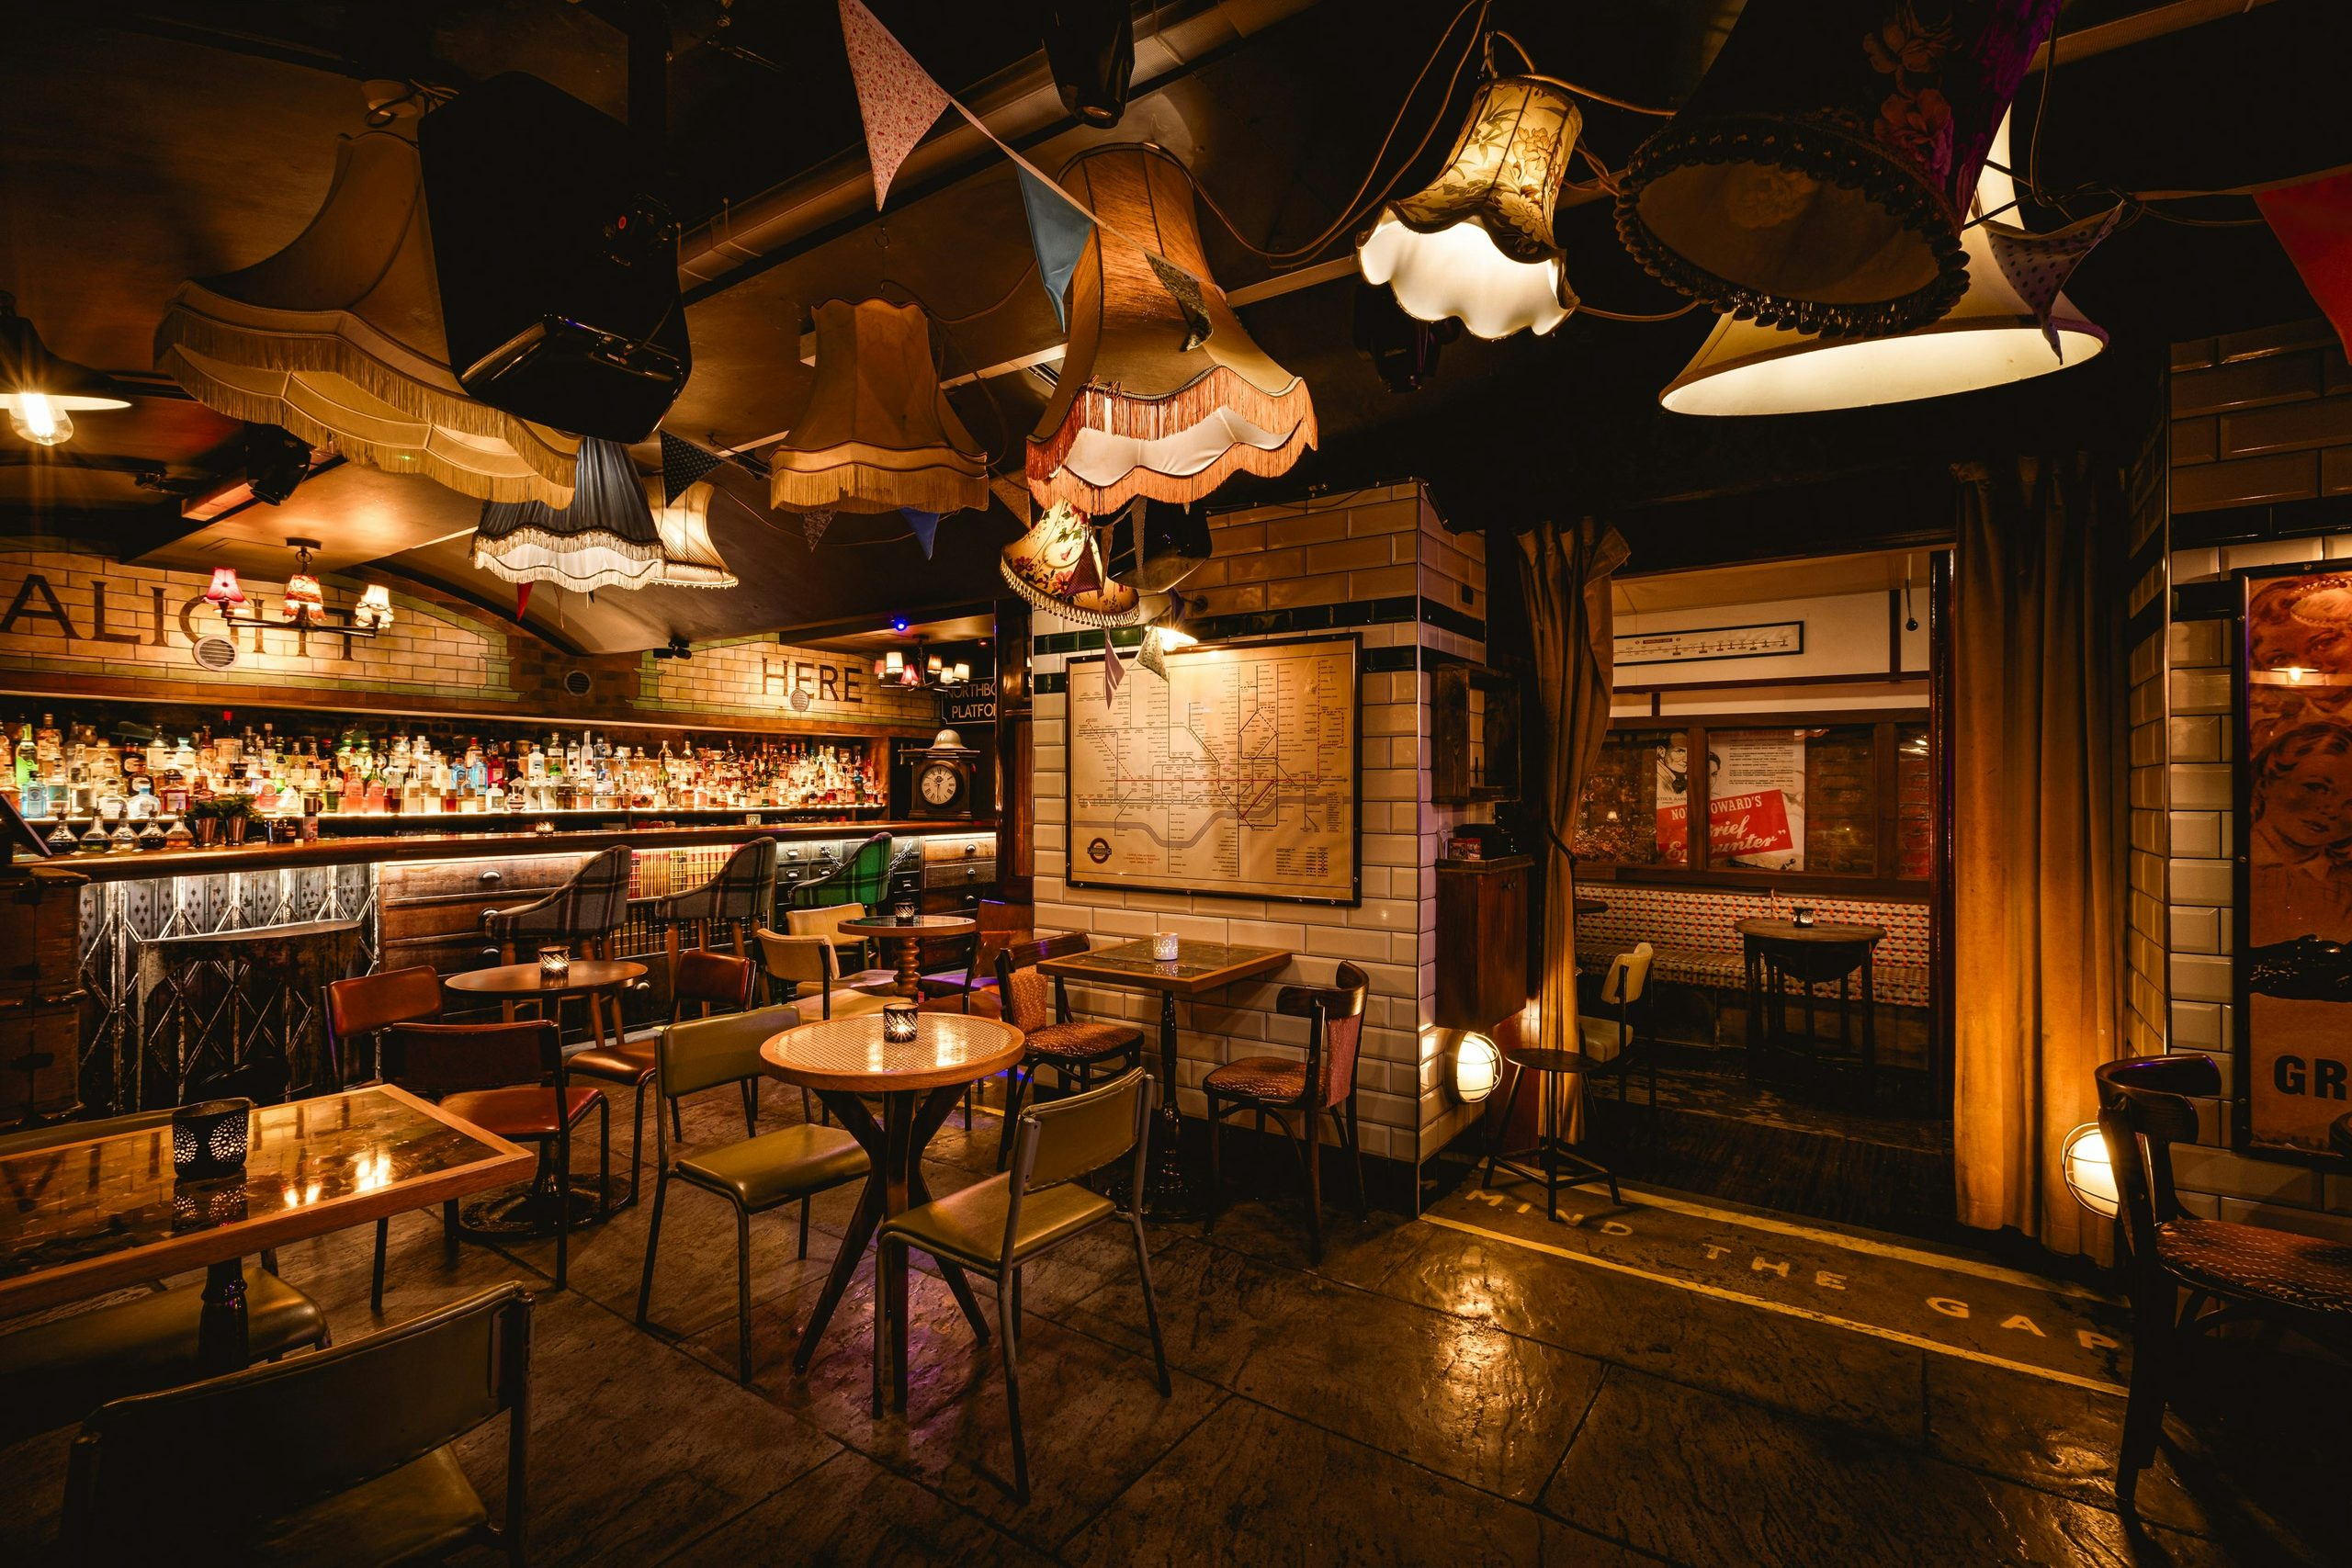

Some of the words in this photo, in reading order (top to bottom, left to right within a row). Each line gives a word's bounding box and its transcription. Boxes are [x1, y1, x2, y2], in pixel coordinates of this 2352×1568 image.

[761, 657, 863, 704] HERE
[1710, 795, 1762, 815] OWARD'S
[1710, 815, 1750, 839] rief
[2273, 1055, 2348, 1101] GR
[1465, 1190, 1634, 1236] MIND
[1702, 1244, 1848, 1291] THE
[1925, 1296, 2120, 1349] GAP
